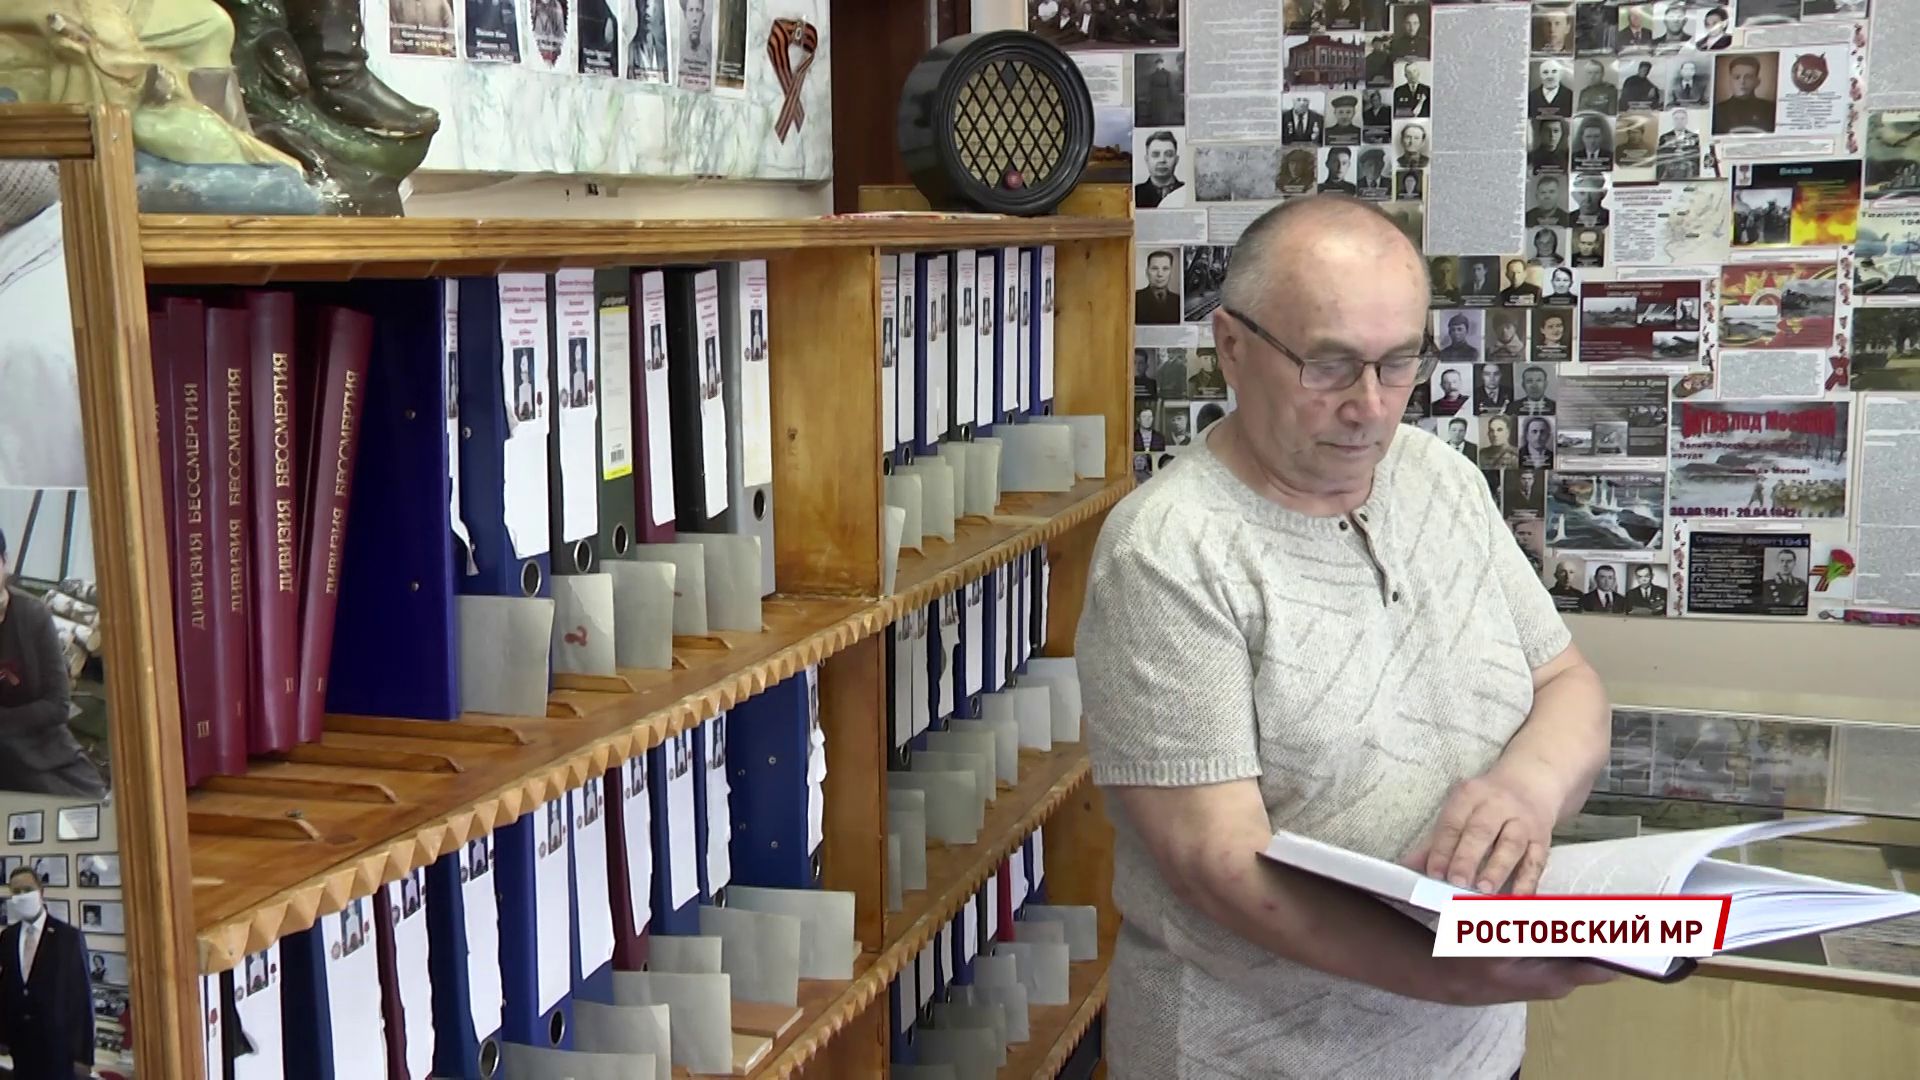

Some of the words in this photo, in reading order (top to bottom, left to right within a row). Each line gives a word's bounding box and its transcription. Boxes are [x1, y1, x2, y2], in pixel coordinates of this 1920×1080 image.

[184, 383, 202, 524] БЕССМЕРТИЯ
[227, 367, 243, 506] БЕССМЕРТИЯ
[272, 352, 290, 488] БЕССМЕРТИЯ
[334, 369, 359, 497] БЕССМЕРТИЯ
[189, 532, 206, 630] ДИВИЗИЯ
[229, 519, 243, 615] ДИВИЗИЯ
[276, 499, 293, 594] ДИВИЗИЯ
[326, 507, 345, 595] ДИВИЗИЯ
